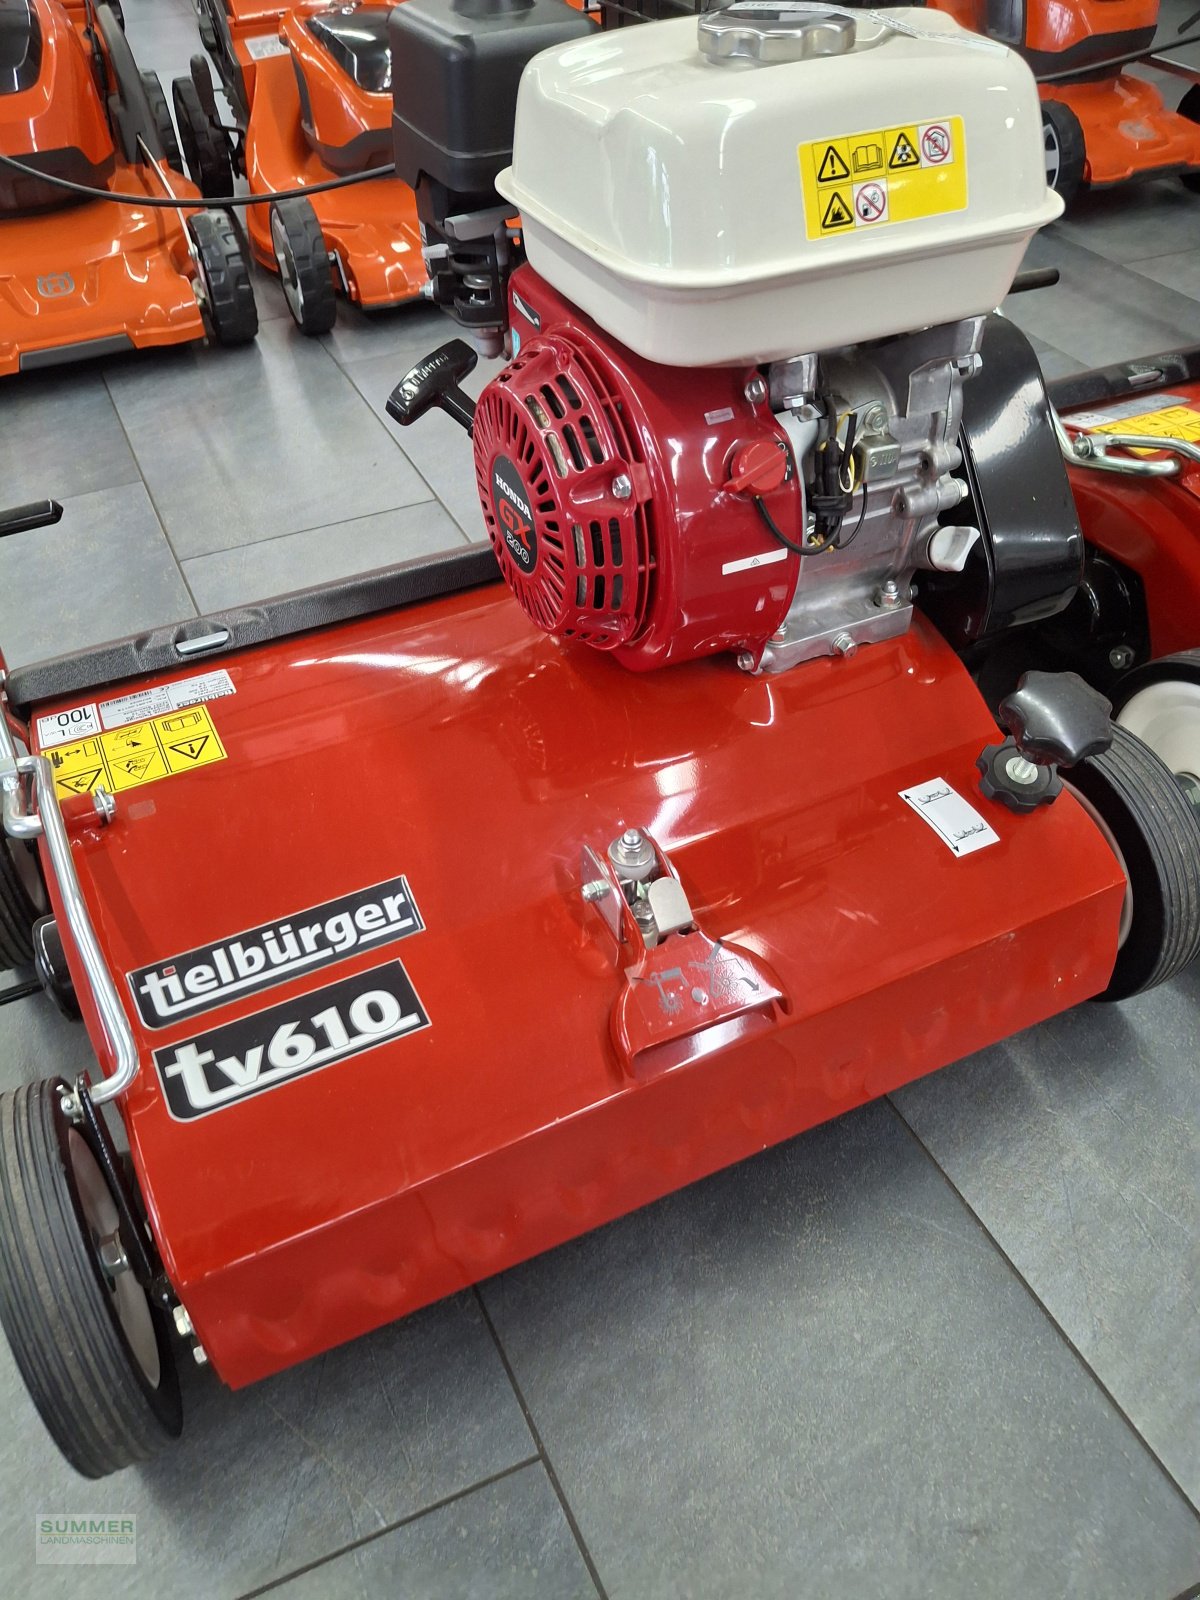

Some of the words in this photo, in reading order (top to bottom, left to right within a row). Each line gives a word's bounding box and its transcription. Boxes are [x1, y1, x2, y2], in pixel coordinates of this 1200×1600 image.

[494, 472, 533, 521] HONDA
[499, 497, 532, 550] GX
[506, 529, 530, 565] 200
[57, 707, 92, 727] 100
[140, 893, 413, 1017] tielbürger
[164, 989, 418, 1109] tv610
